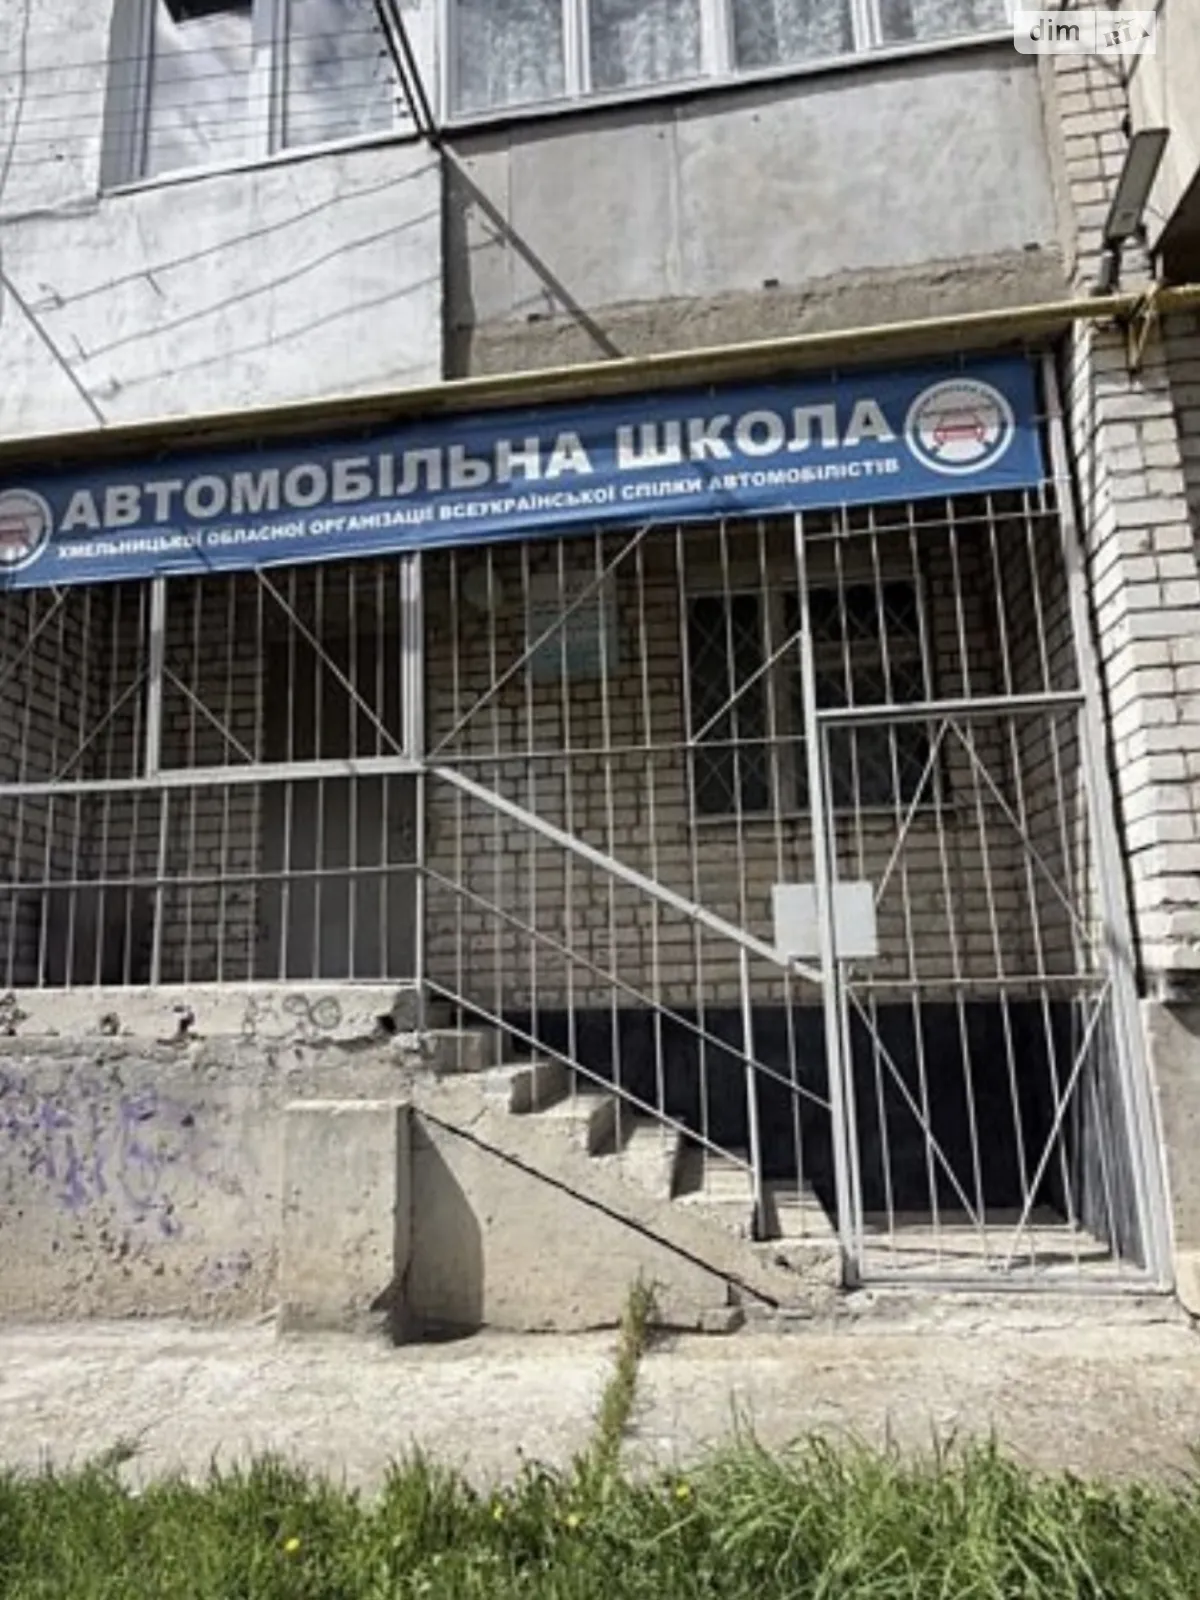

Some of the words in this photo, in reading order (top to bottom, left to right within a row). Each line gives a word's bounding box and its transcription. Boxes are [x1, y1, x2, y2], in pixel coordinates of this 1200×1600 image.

[59, 430, 592, 532] АВТОМОБІЛЬНА
[617, 399, 897, 469] ШКОЛА
[206, 519, 305, 545] ОБЛАСНОЇ
[309, 507, 434, 536] ОРГАНІЗАЦІЇ
[439, 484, 616, 521] ВСЕУКРАЇНСЬКОЇ
[621, 477, 702, 500] СПІЛКИ
[709, 457, 899, 491] АВТОМОБІЛІСТІВ
